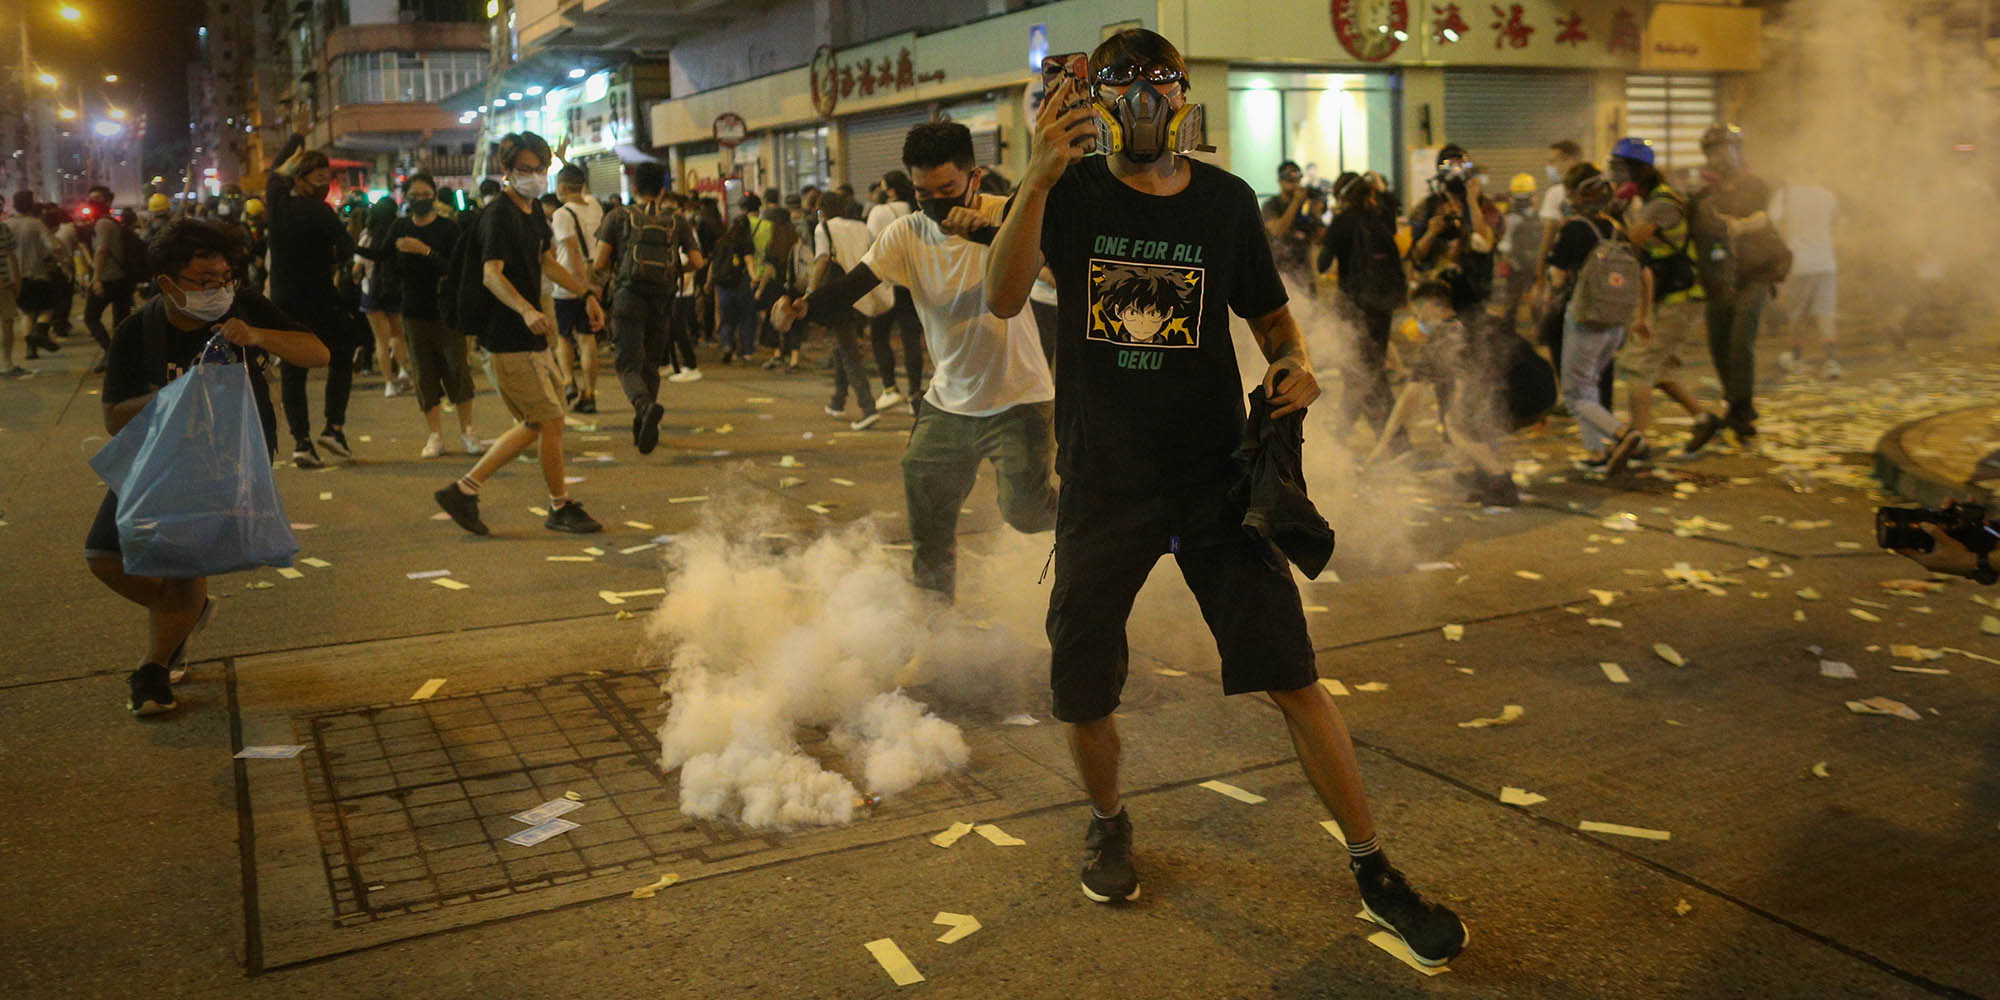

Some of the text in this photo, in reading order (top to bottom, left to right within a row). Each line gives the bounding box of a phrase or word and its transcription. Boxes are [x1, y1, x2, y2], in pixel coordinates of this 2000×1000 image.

[1094, 235, 1203, 263] ONE FOR ALL
[1117, 349, 1164, 370] DEKU
